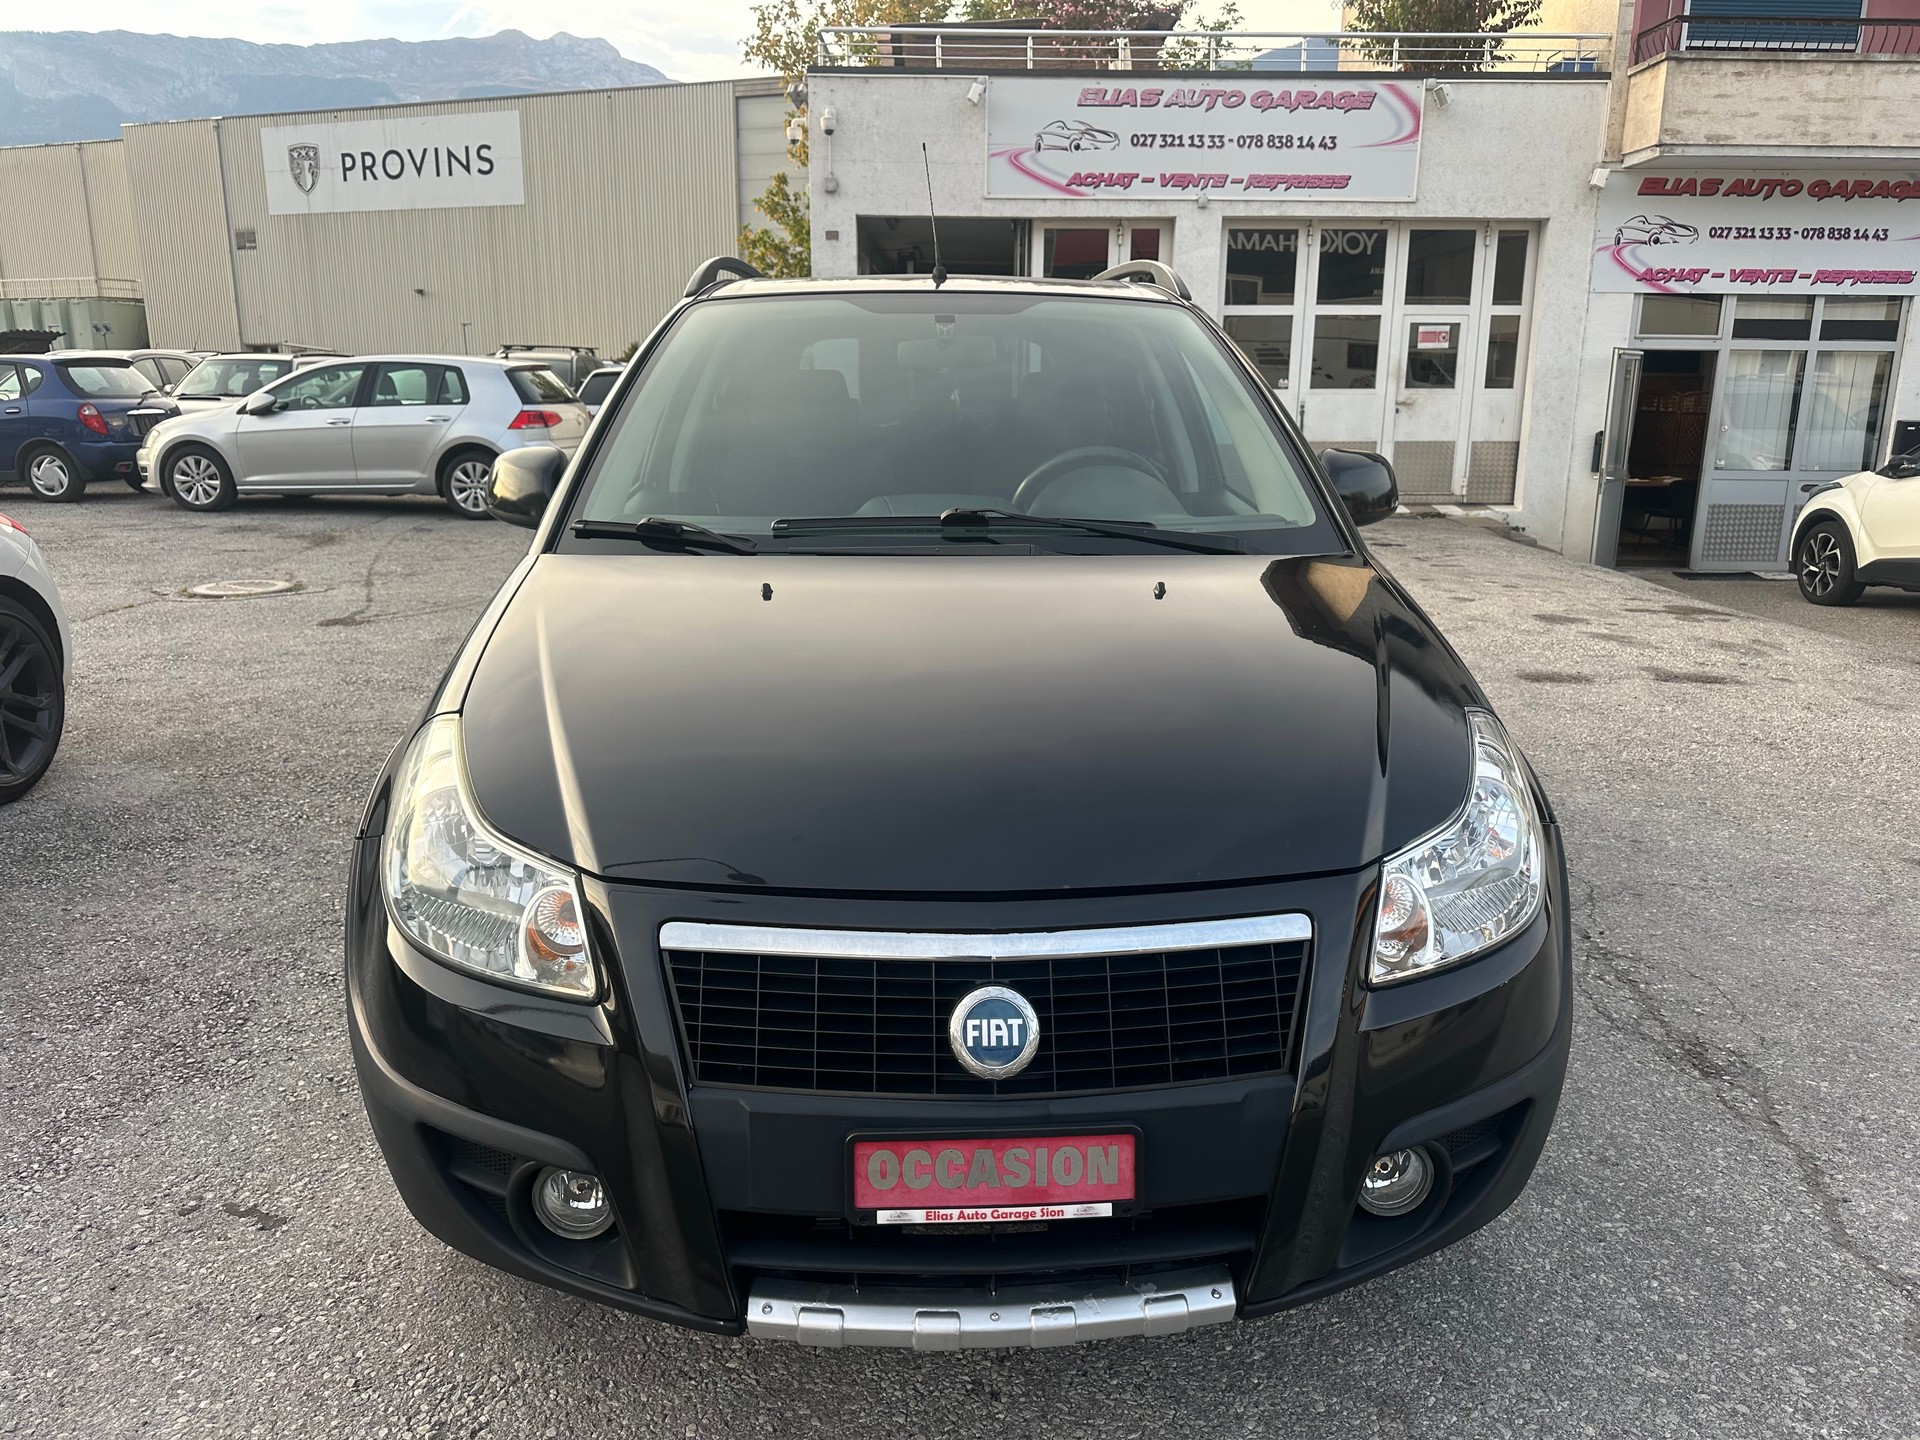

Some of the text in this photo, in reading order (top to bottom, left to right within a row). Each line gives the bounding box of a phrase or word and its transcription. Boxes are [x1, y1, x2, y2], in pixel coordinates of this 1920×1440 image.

[1077, 88, 1377, 114] ELIAS AUTO GARAGE
[1130, 133, 1157, 148] 027
[1159, 133, 1185, 148] 321
[1188, 134, 1205, 149] 13
[1207, 134, 1225, 149] 33
[1236, 134, 1264, 149] 078
[1266, 135, 1294, 149] 838
[1296, 135, 1315, 150] 14
[1318, 135, 1337, 150] 43
[341, 143, 494, 182] PROVINS
[1065, 172, 1139, 190] ACHAT
[1159, 173, 1230, 191] VENTE
[1243, 173, 1352, 192] REPRISES
[1637, 177, 1724, 197] ELIAS
[1722, 178, 1804, 202] AUTO
[1709, 226, 1732, 239] 027
[1733, 226, 1756, 240] 321
[1759, 227, 1774, 240] 13
[1775, 227, 1791, 240] 33
[1801, 227, 1825, 240] 078
[1827, 227, 1851, 240] 838
[1853, 228, 1869, 241] 14
[1871, 228, 1889, 241] 43
[1636, 268, 1709, 285] ACHAT
[1729, 268, 1798, 285] VENTE
[1810, 269, 1914, 286] REPRISES
[966, 1018, 1023, 1047] FIAT
[867, 1145, 1119, 1190] OCCASION
[925, 1210, 954, 1221] Elias
[956, 1209, 988, 1220] Auto
[990, 1209, 1036, 1222] Garage
[1040, 1207, 1065, 1219] Sion
